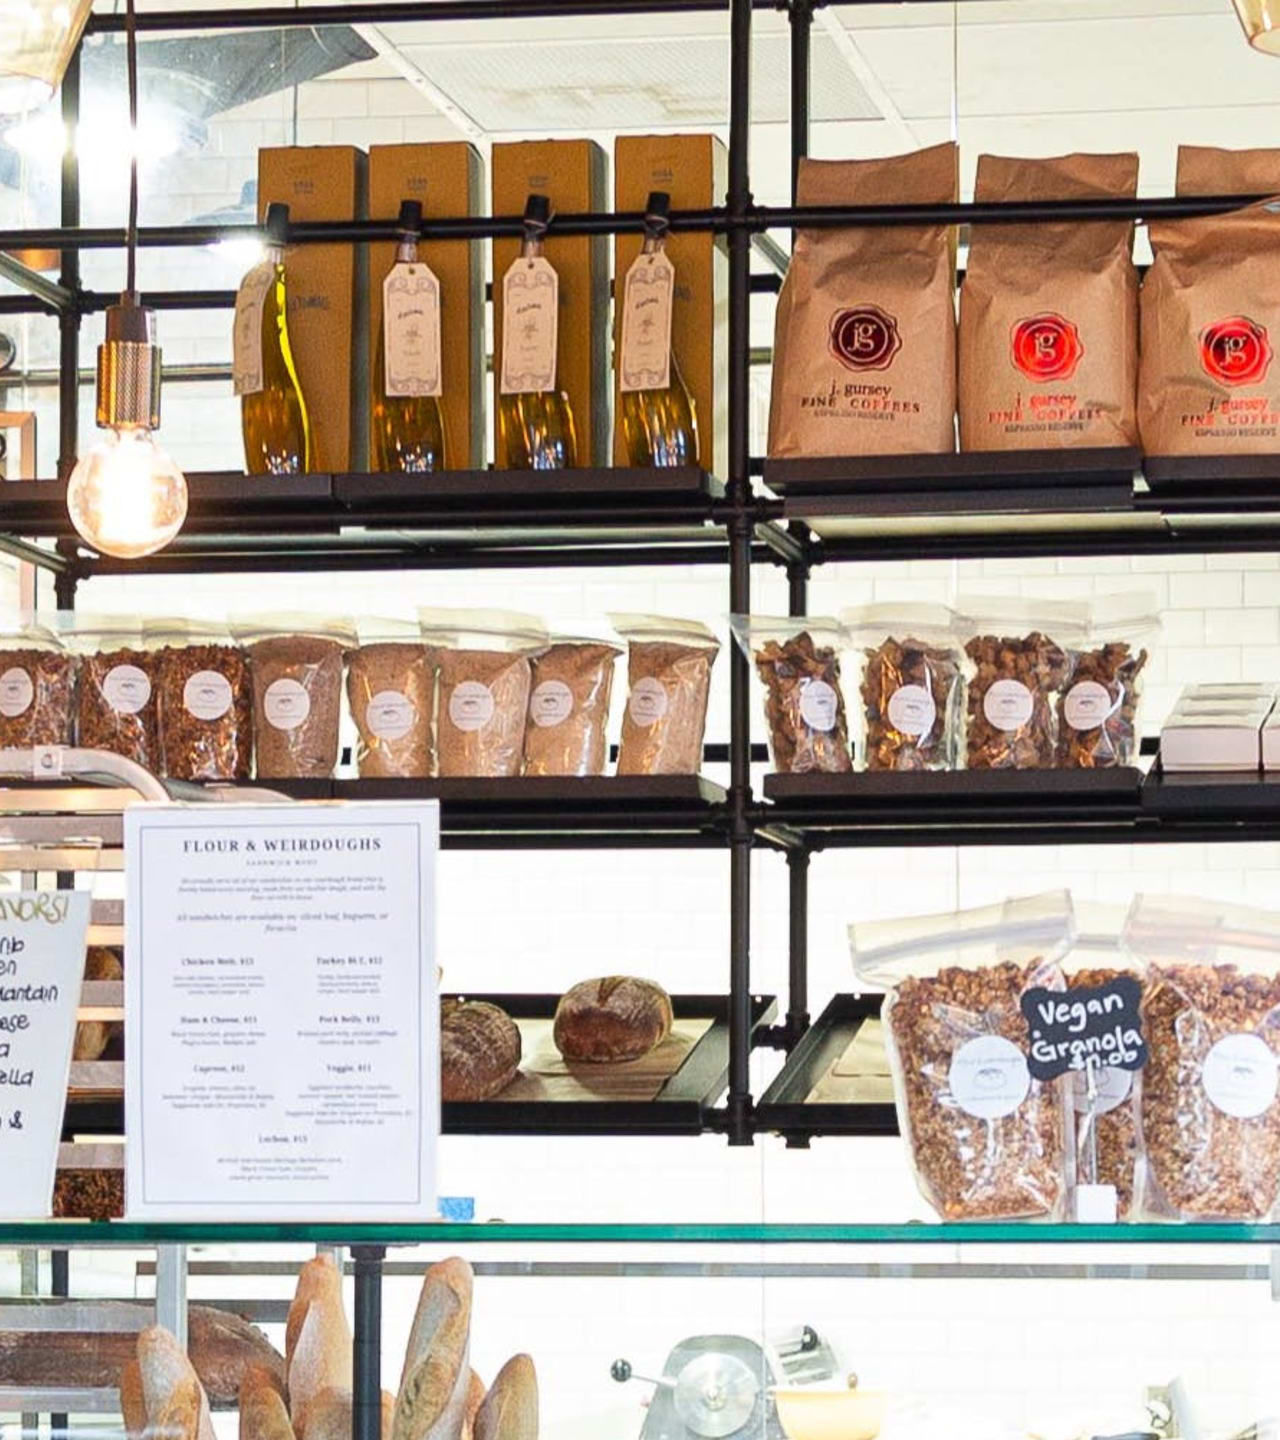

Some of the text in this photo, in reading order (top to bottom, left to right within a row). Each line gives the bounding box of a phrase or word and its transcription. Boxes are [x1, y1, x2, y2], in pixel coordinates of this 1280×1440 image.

[850, 398, 921, 414] COFFEES
[183, 837, 383, 854] FLOUR & WEIRDOUGHS
[1038, 993, 1124, 1032] Vegan
[1032, 1026, 1144, 1063] Granola
